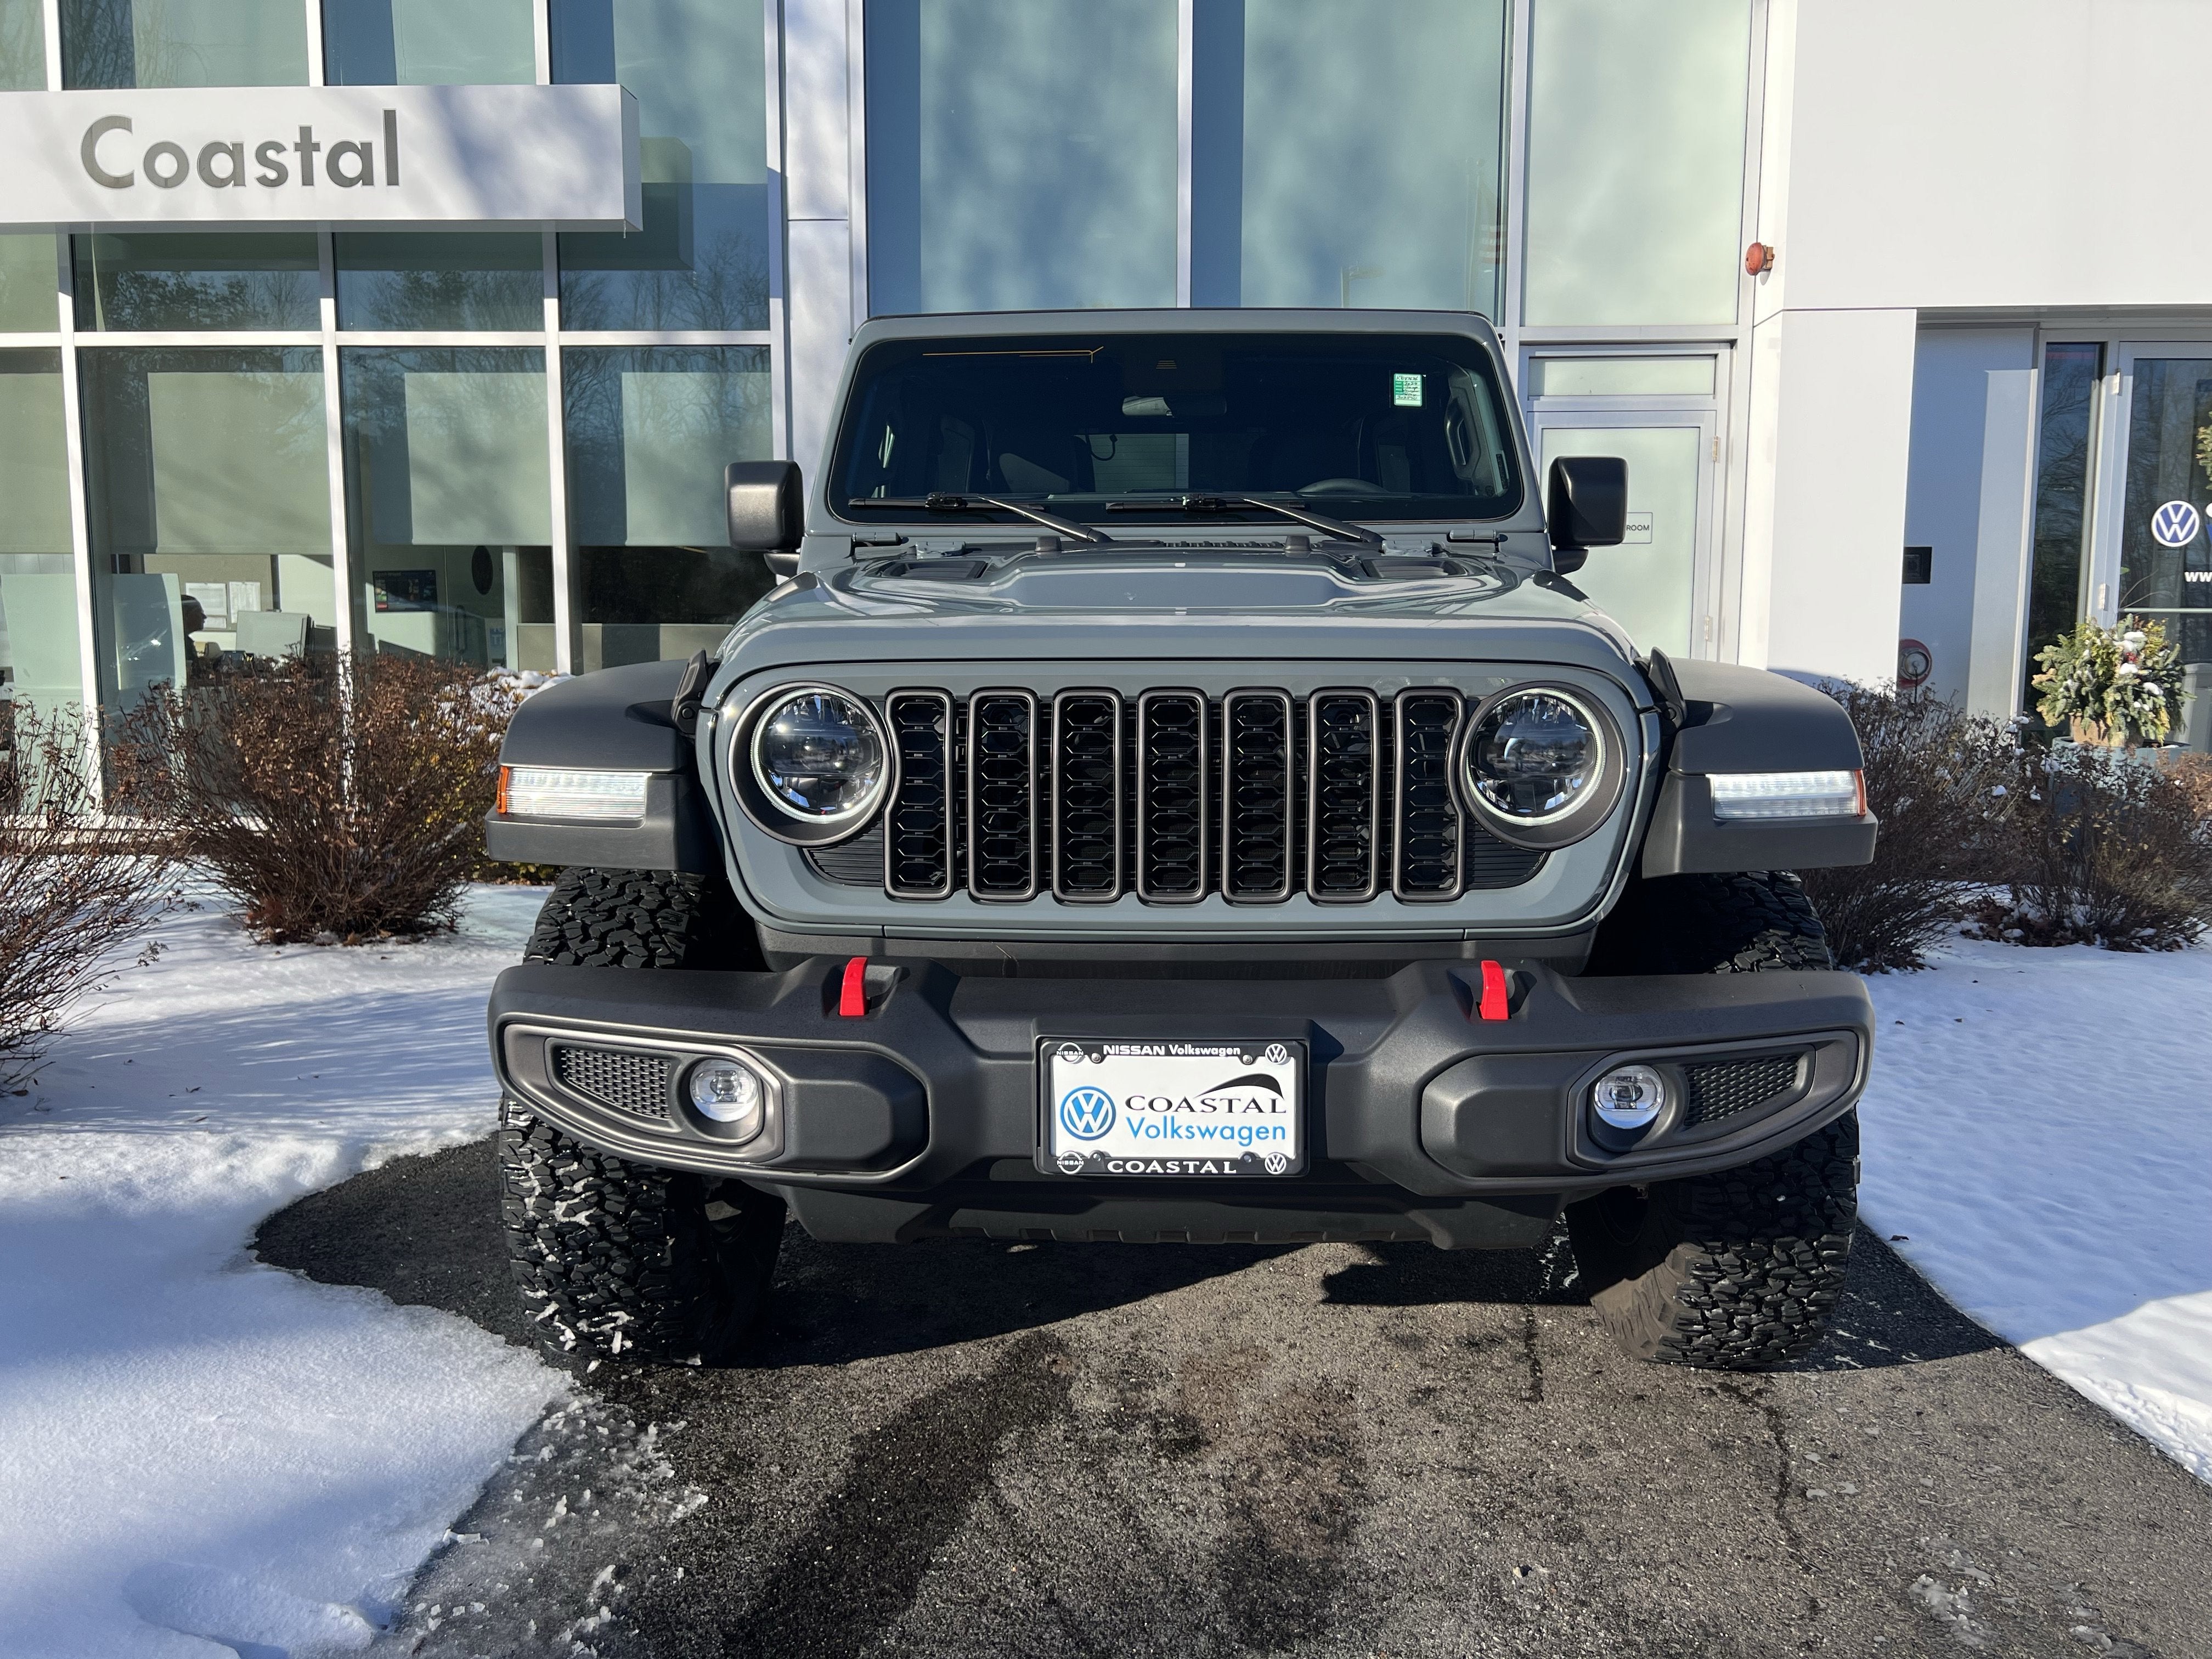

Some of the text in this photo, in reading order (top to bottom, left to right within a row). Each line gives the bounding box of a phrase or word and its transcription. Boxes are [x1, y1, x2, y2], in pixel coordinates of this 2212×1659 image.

[81, 108, 399, 189] Coastal
[1103, 1043, 1241, 1057] NISSAN Volkswagen
[1125, 1096, 1287, 1114] COASTAL
[1125, 1115, 1286, 1147] Volkswagen
[1107, 1160, 1237, 1174] COASTAL
